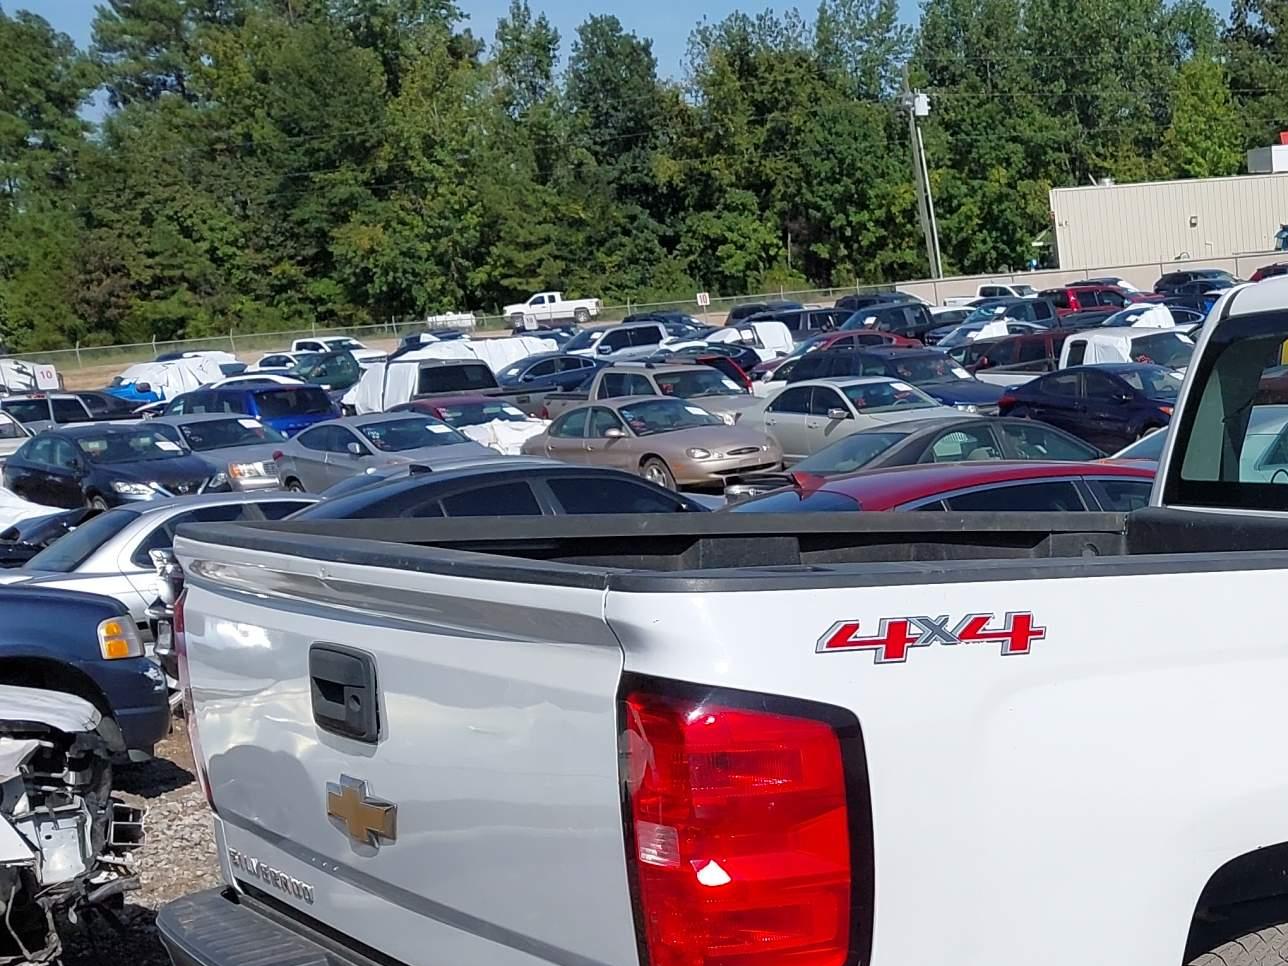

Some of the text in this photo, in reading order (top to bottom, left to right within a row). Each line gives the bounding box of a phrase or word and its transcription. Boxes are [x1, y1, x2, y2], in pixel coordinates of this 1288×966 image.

[698, 294, 708, 305] 10
[40, 369, 53, 380] 10
[229, 847, 314, 905] SILVERADO
